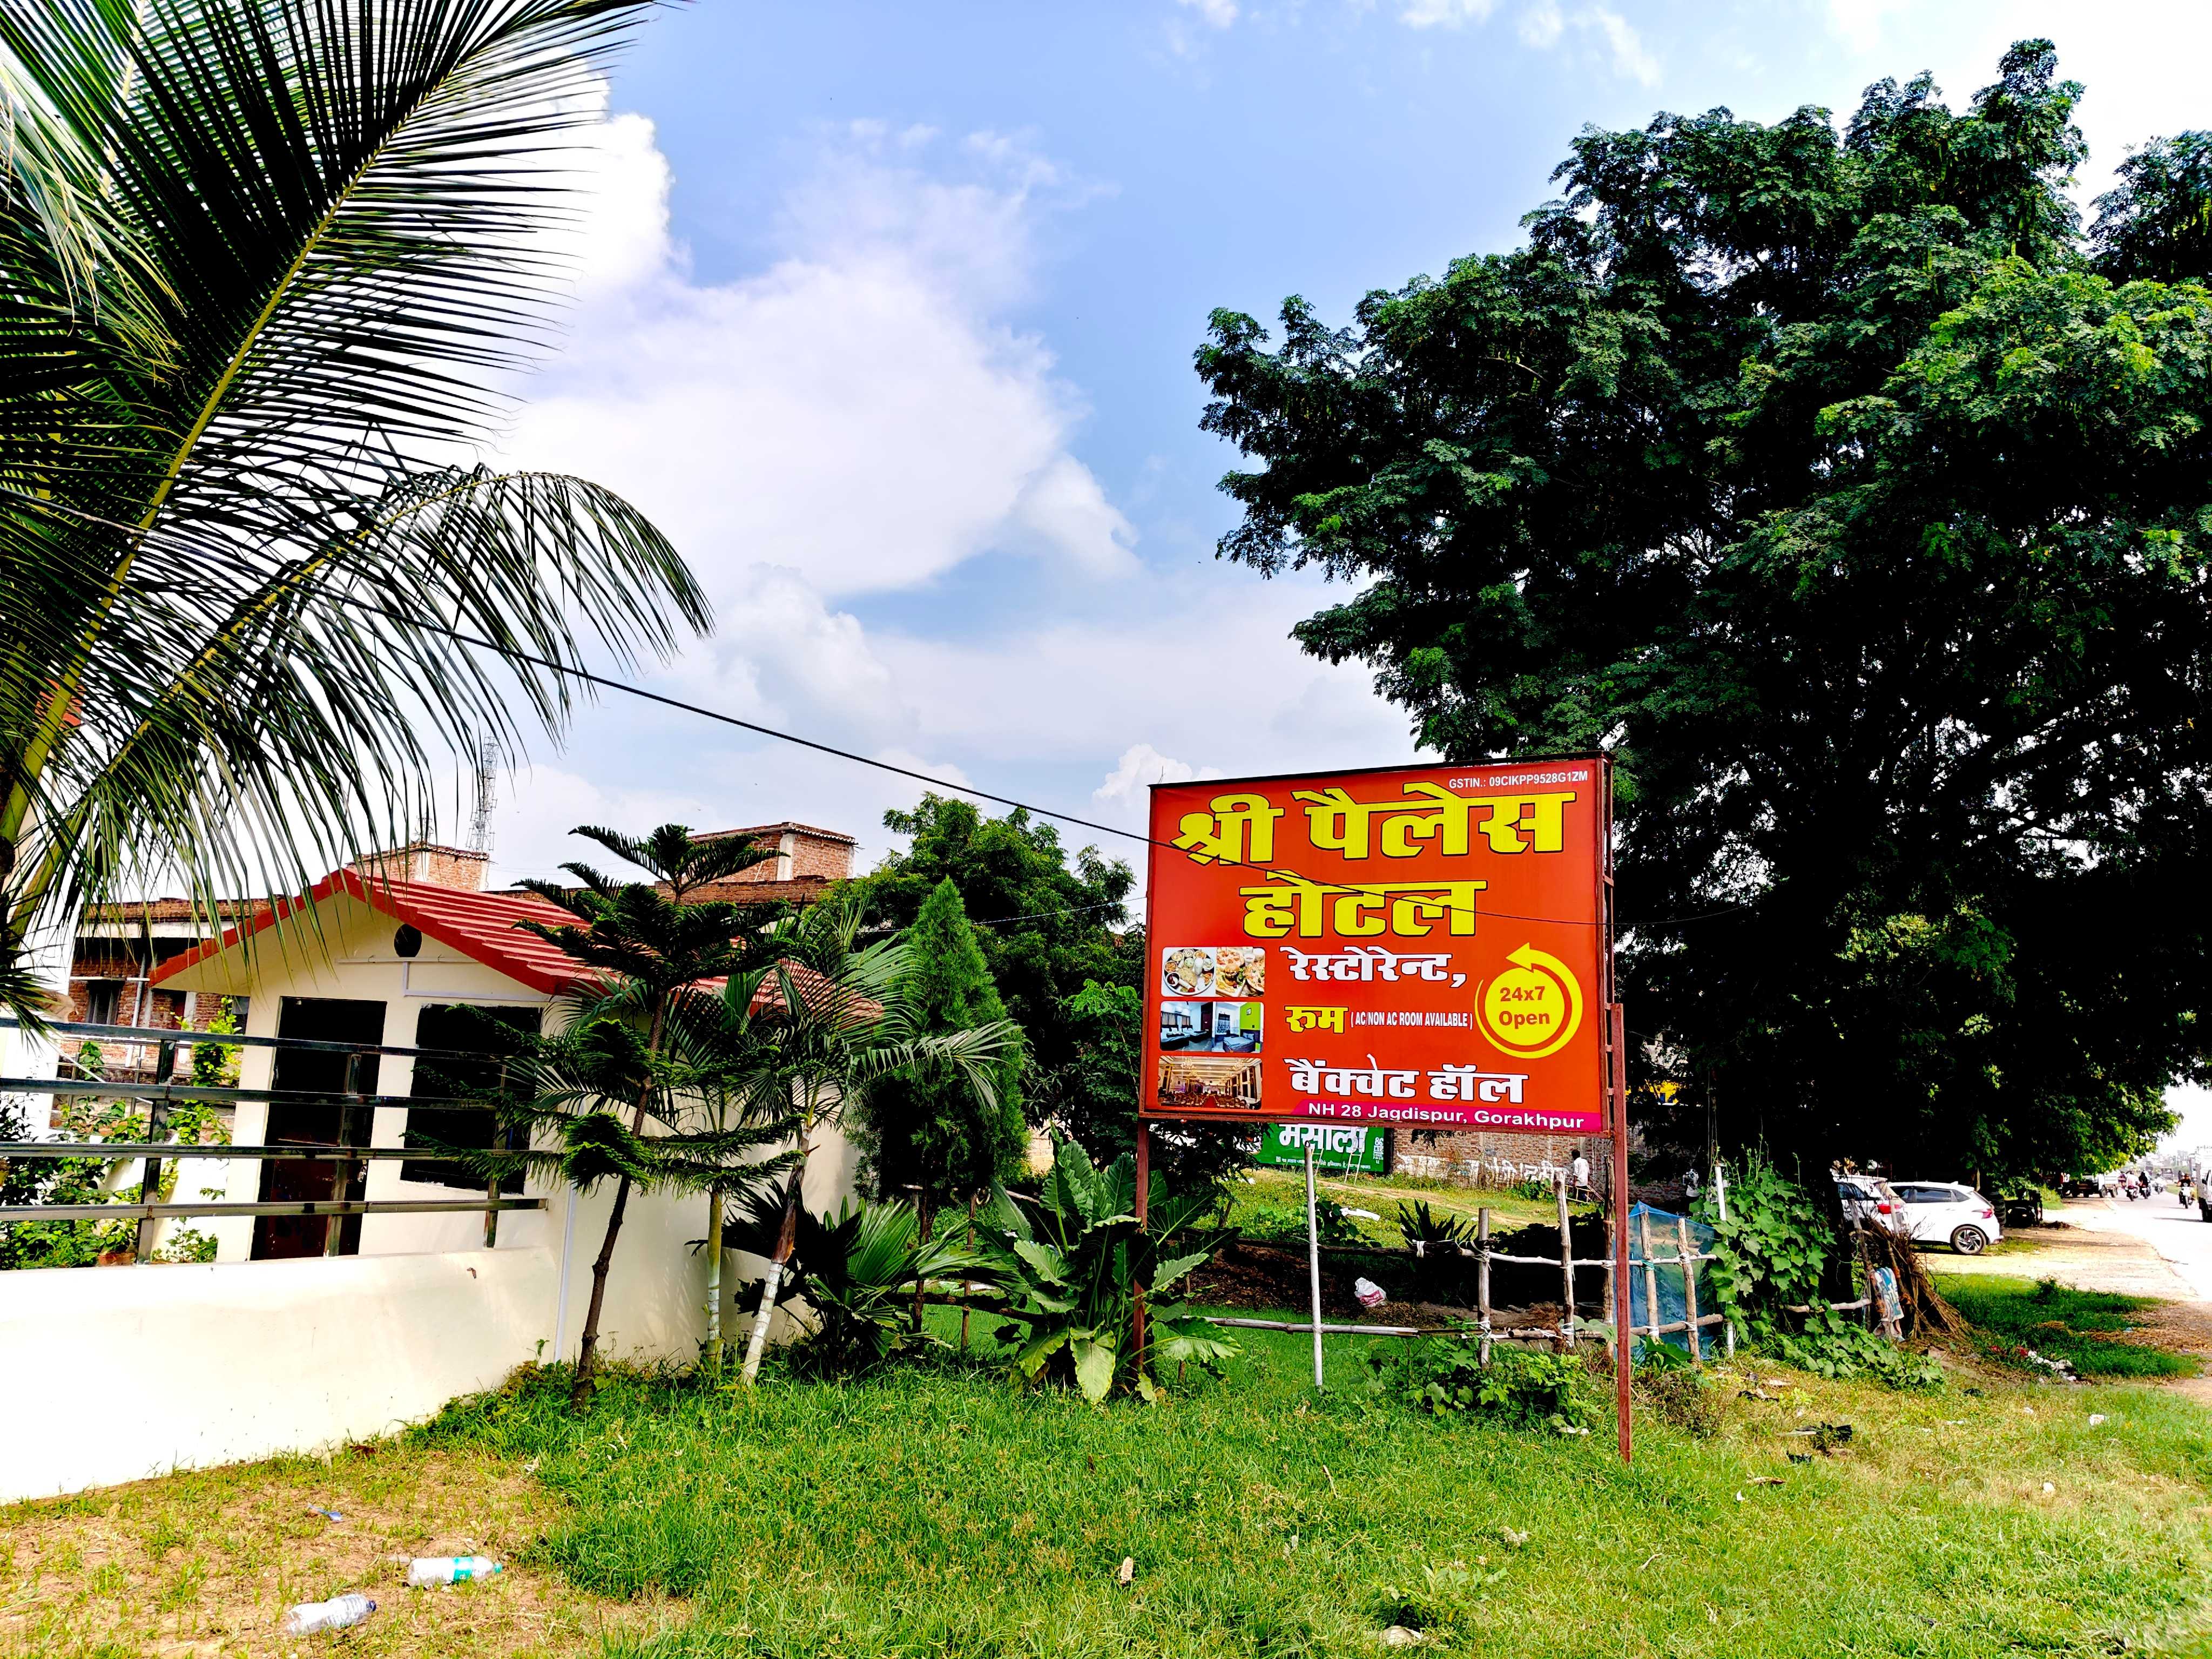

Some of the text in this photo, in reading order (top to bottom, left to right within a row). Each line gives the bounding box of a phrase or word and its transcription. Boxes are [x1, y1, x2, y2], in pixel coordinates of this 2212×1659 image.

[1489, 771, 1588, 787] 09CIKPP9528G1ZM
[1170, 781, 1577, 866] श्री पैलेस
[1239, 869, 1488, 938] होटल
[1279, 946, 1467, 988] रेस्टोरेन्ट,
[1500, 986, 1545, 1002] 24x7
[1386, 1012, 1397, 1027] AC
[1399, 1012, 1423, 1027] ROOM
[1499, 1010, 1550, 1029] Open
[1426, 1063, 1529, 1104] हॉल
[1309, 1103, 1585, 1130] NH 28 Jagdispur, Gorakhpur
[1278, 1123, 1368, 1154] मसाला
